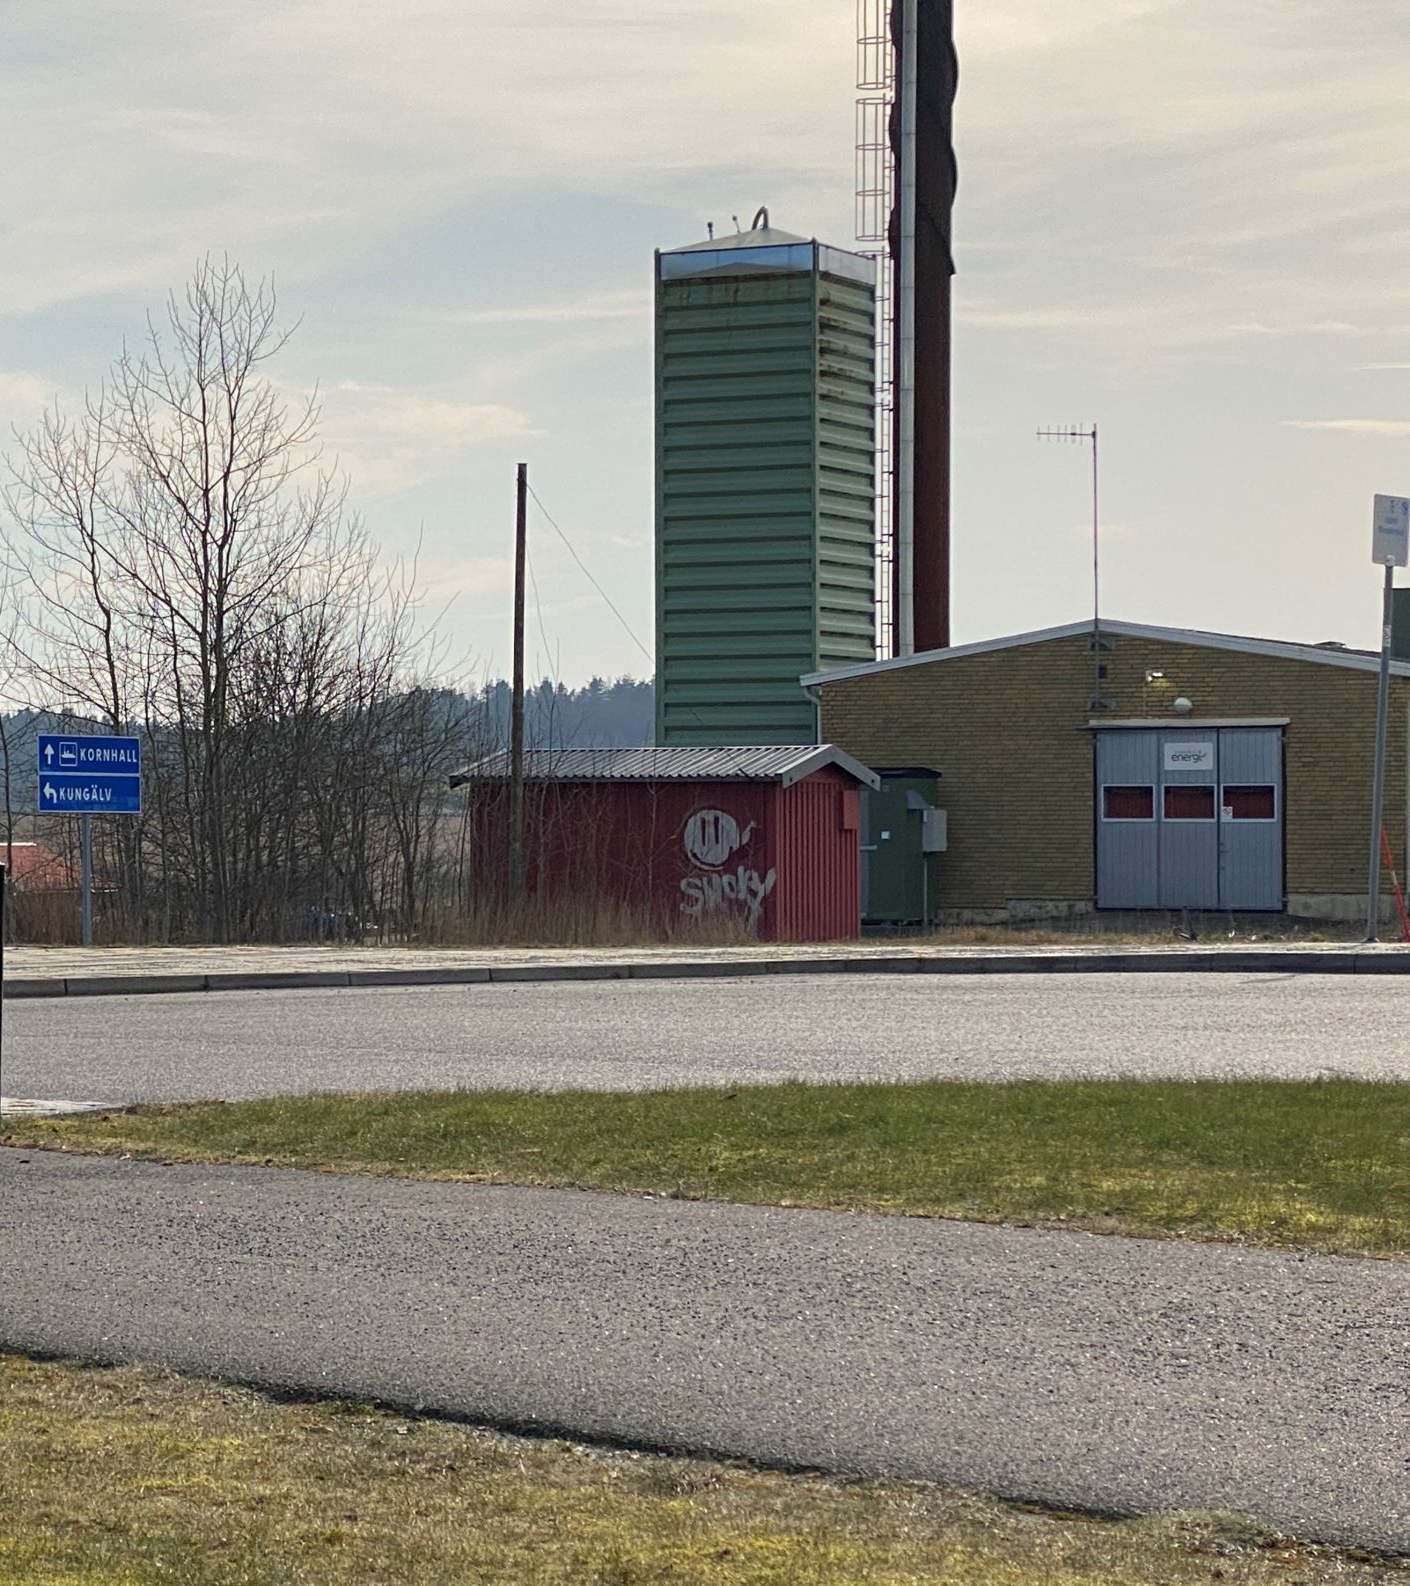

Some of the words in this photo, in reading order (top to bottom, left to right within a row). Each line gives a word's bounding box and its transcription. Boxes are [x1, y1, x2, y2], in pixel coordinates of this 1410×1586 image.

[79, 748, 137, 763] KORNHALL
[1171, 750, 1203, 764] energi
[59, 784, 112, 801] KUNGÄLV
